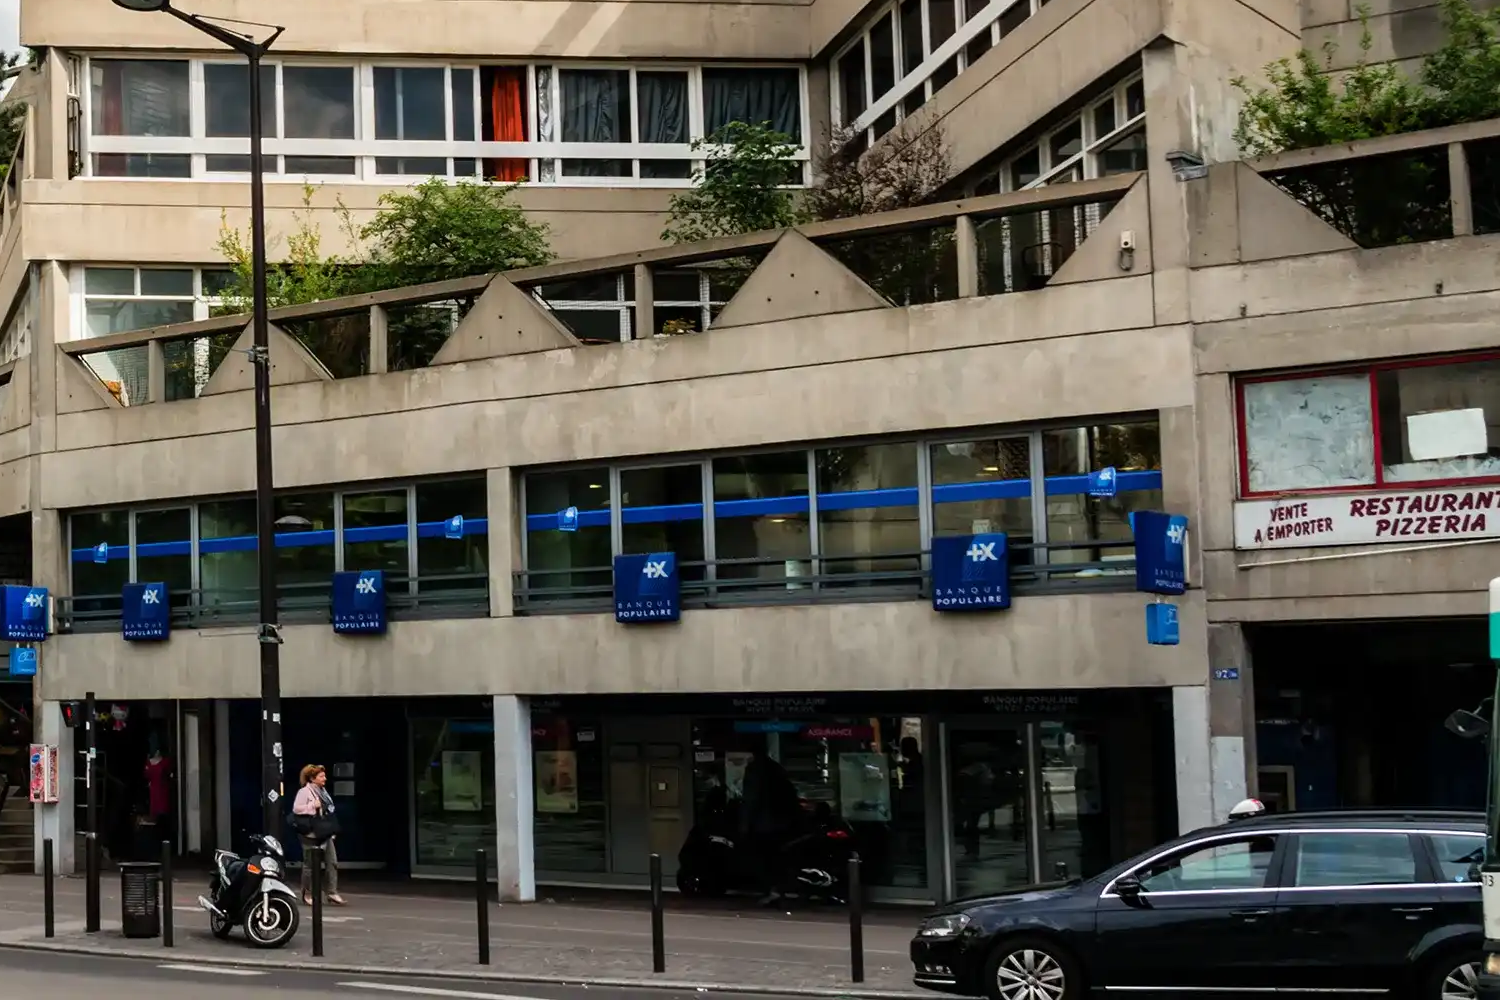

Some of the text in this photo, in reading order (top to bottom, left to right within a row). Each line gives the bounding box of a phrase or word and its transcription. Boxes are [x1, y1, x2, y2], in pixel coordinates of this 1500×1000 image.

[1270, 502, 1308, 522] VENTE
[1376, 513, 1486, 537] PIZZERIA
[1254, 517, 1333, 543] A EMPORTER
[936, 586, 1001, 596] BANQUE
[618, 600, 672, 609] BANQUE
[936, 595, 1002, 605] POPULAIRE
[618, 609, 671, 617] POPULAIRE
[8, 623, 44, 631] BANQUE
[8, 631, 45, 639] POPULAIRE
[807, 728, 852, 737] ASSURANCE
